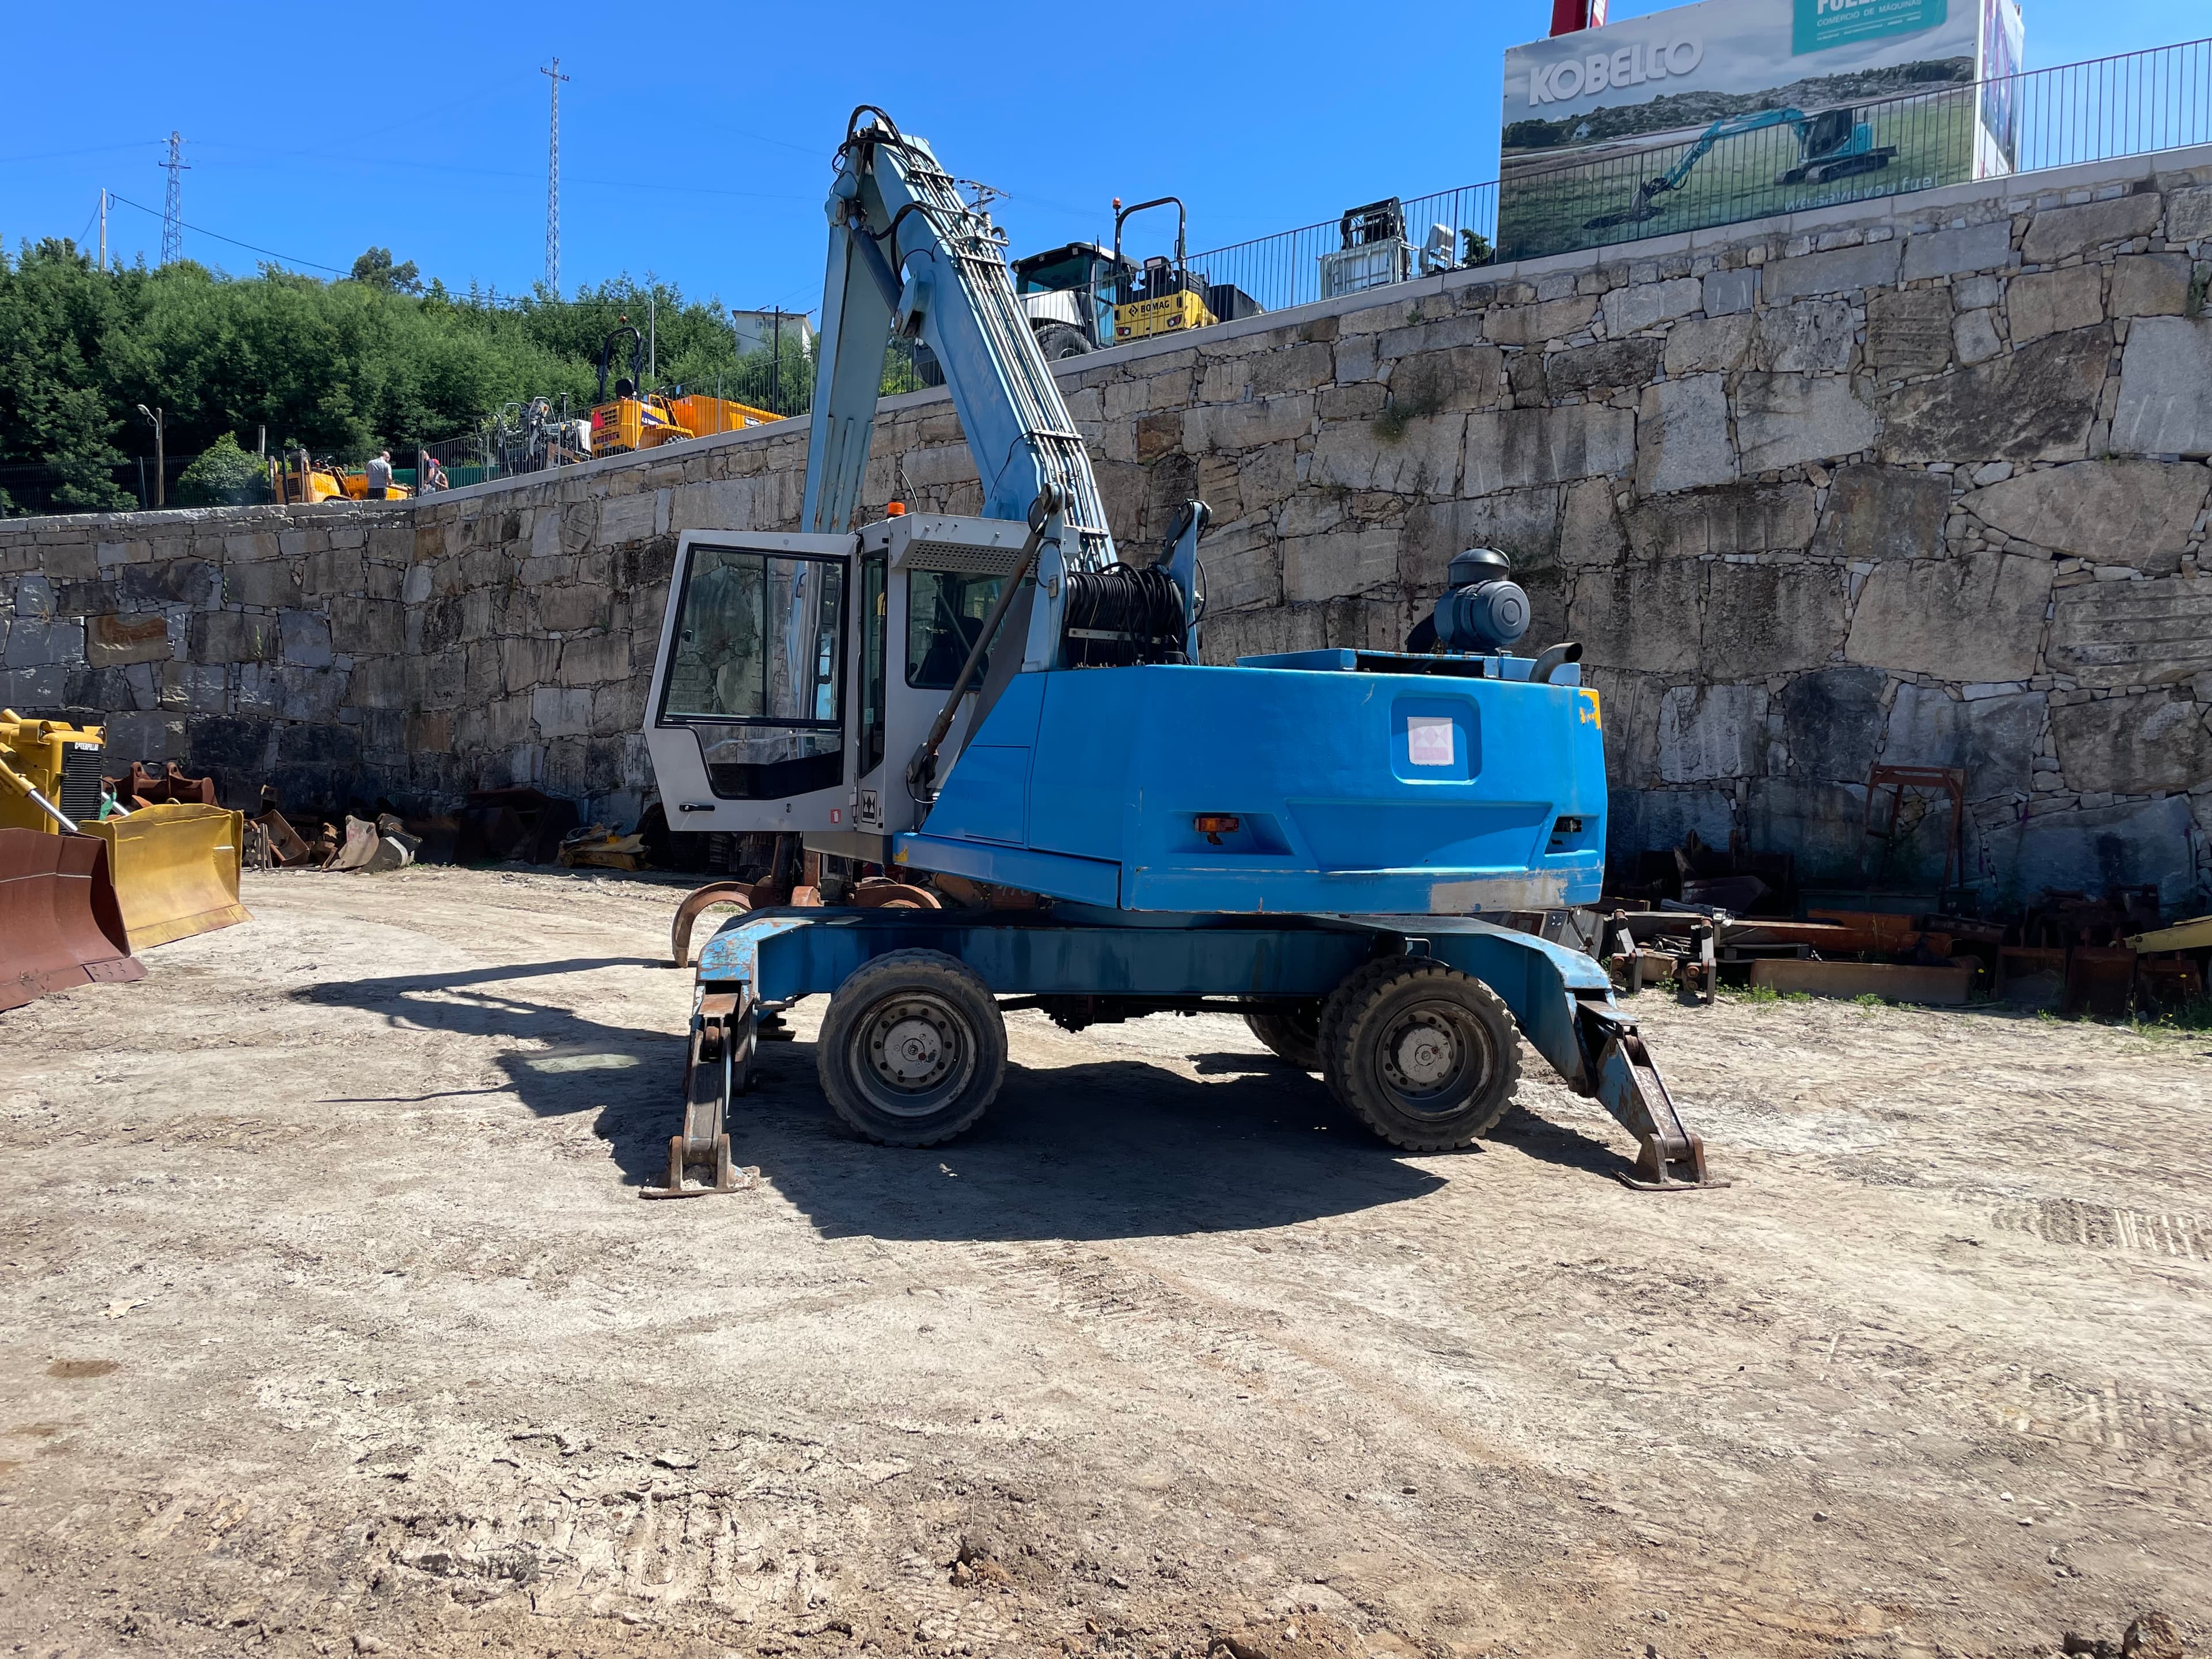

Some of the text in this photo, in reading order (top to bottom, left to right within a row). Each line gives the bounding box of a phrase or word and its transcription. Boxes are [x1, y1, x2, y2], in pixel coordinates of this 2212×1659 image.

[1863, 8, 1875, 17] DE
[1529, 35, 1703, 106] KOBELCO
[1902, 171, 1938, 192] fuel
[1141, 300, 1169, 313] BOMAG
